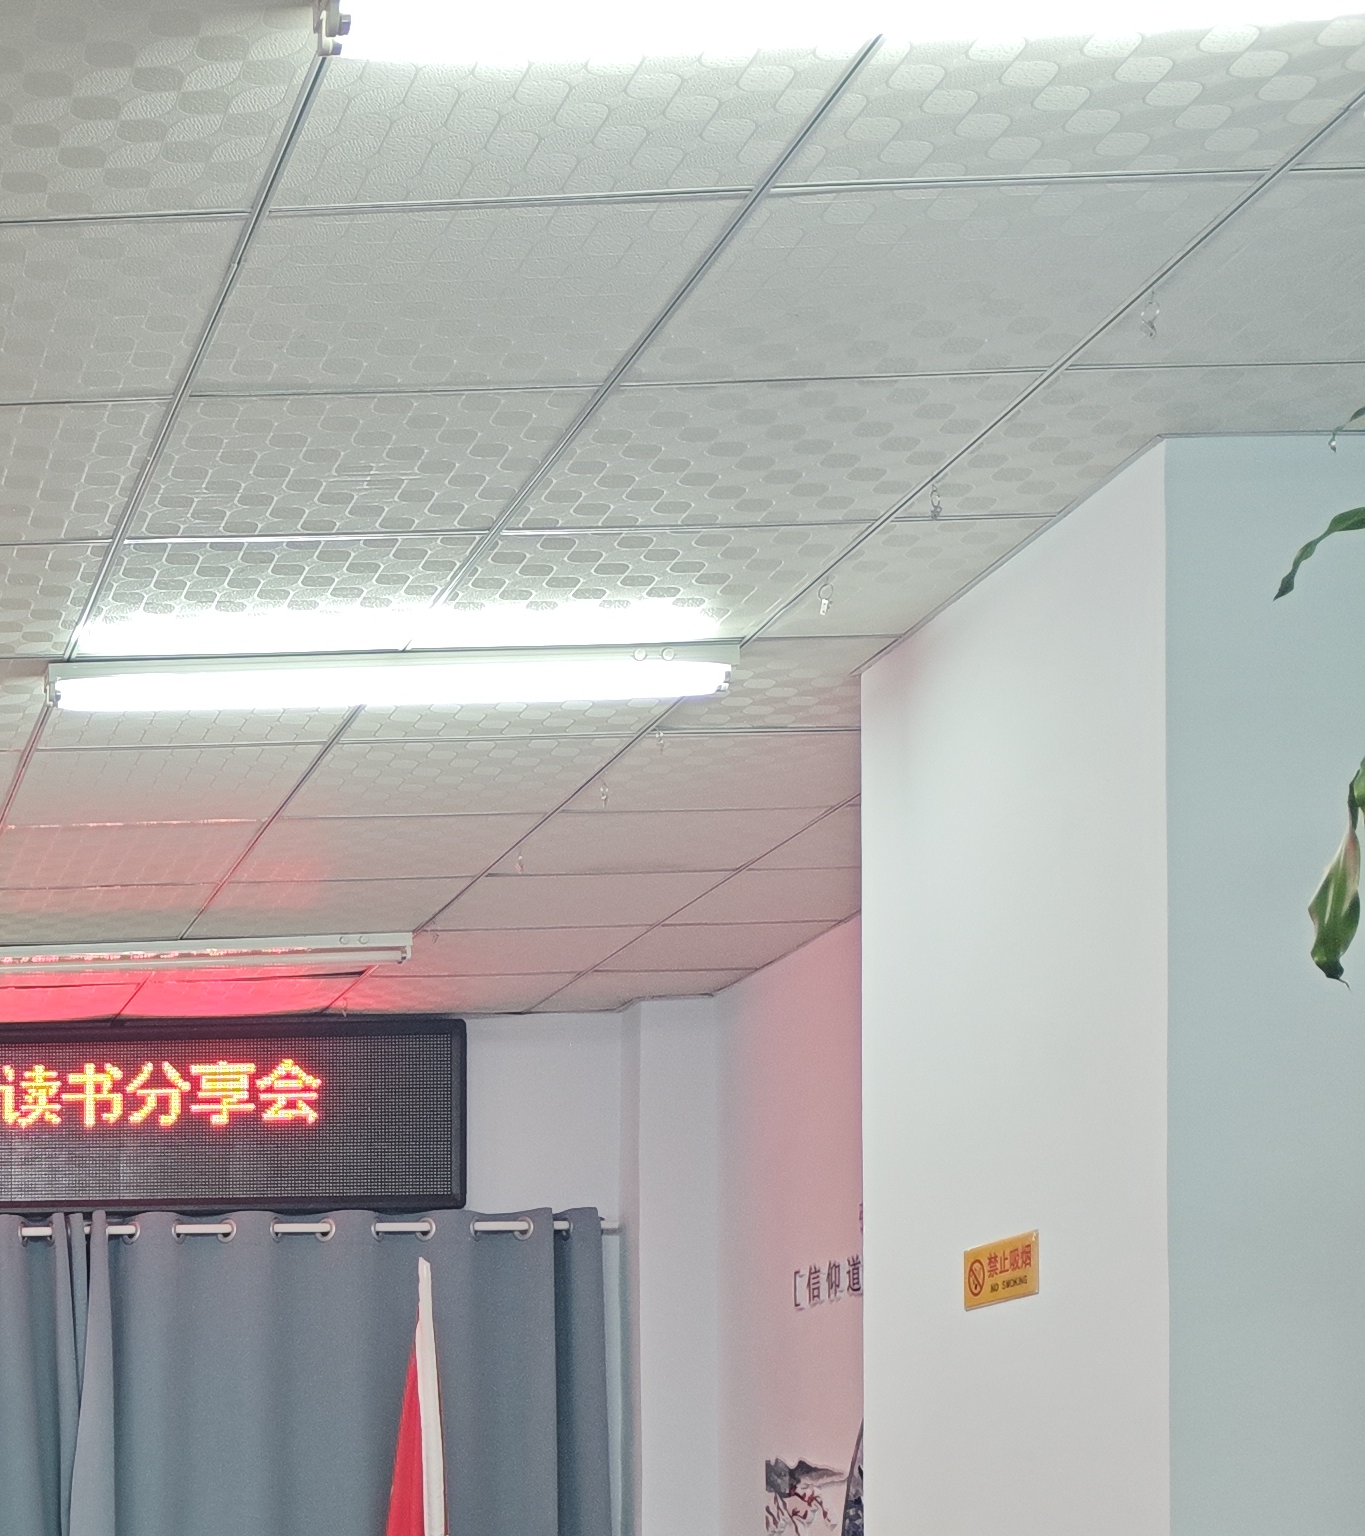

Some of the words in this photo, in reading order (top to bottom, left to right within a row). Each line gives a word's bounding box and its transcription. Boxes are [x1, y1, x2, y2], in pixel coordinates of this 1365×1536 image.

[987, 1243, 1032, 1279] 禁止吸烟
[990, 1282, 1000, 1293] NO
[1001, 1274, 1028, 1290] SMOKING
